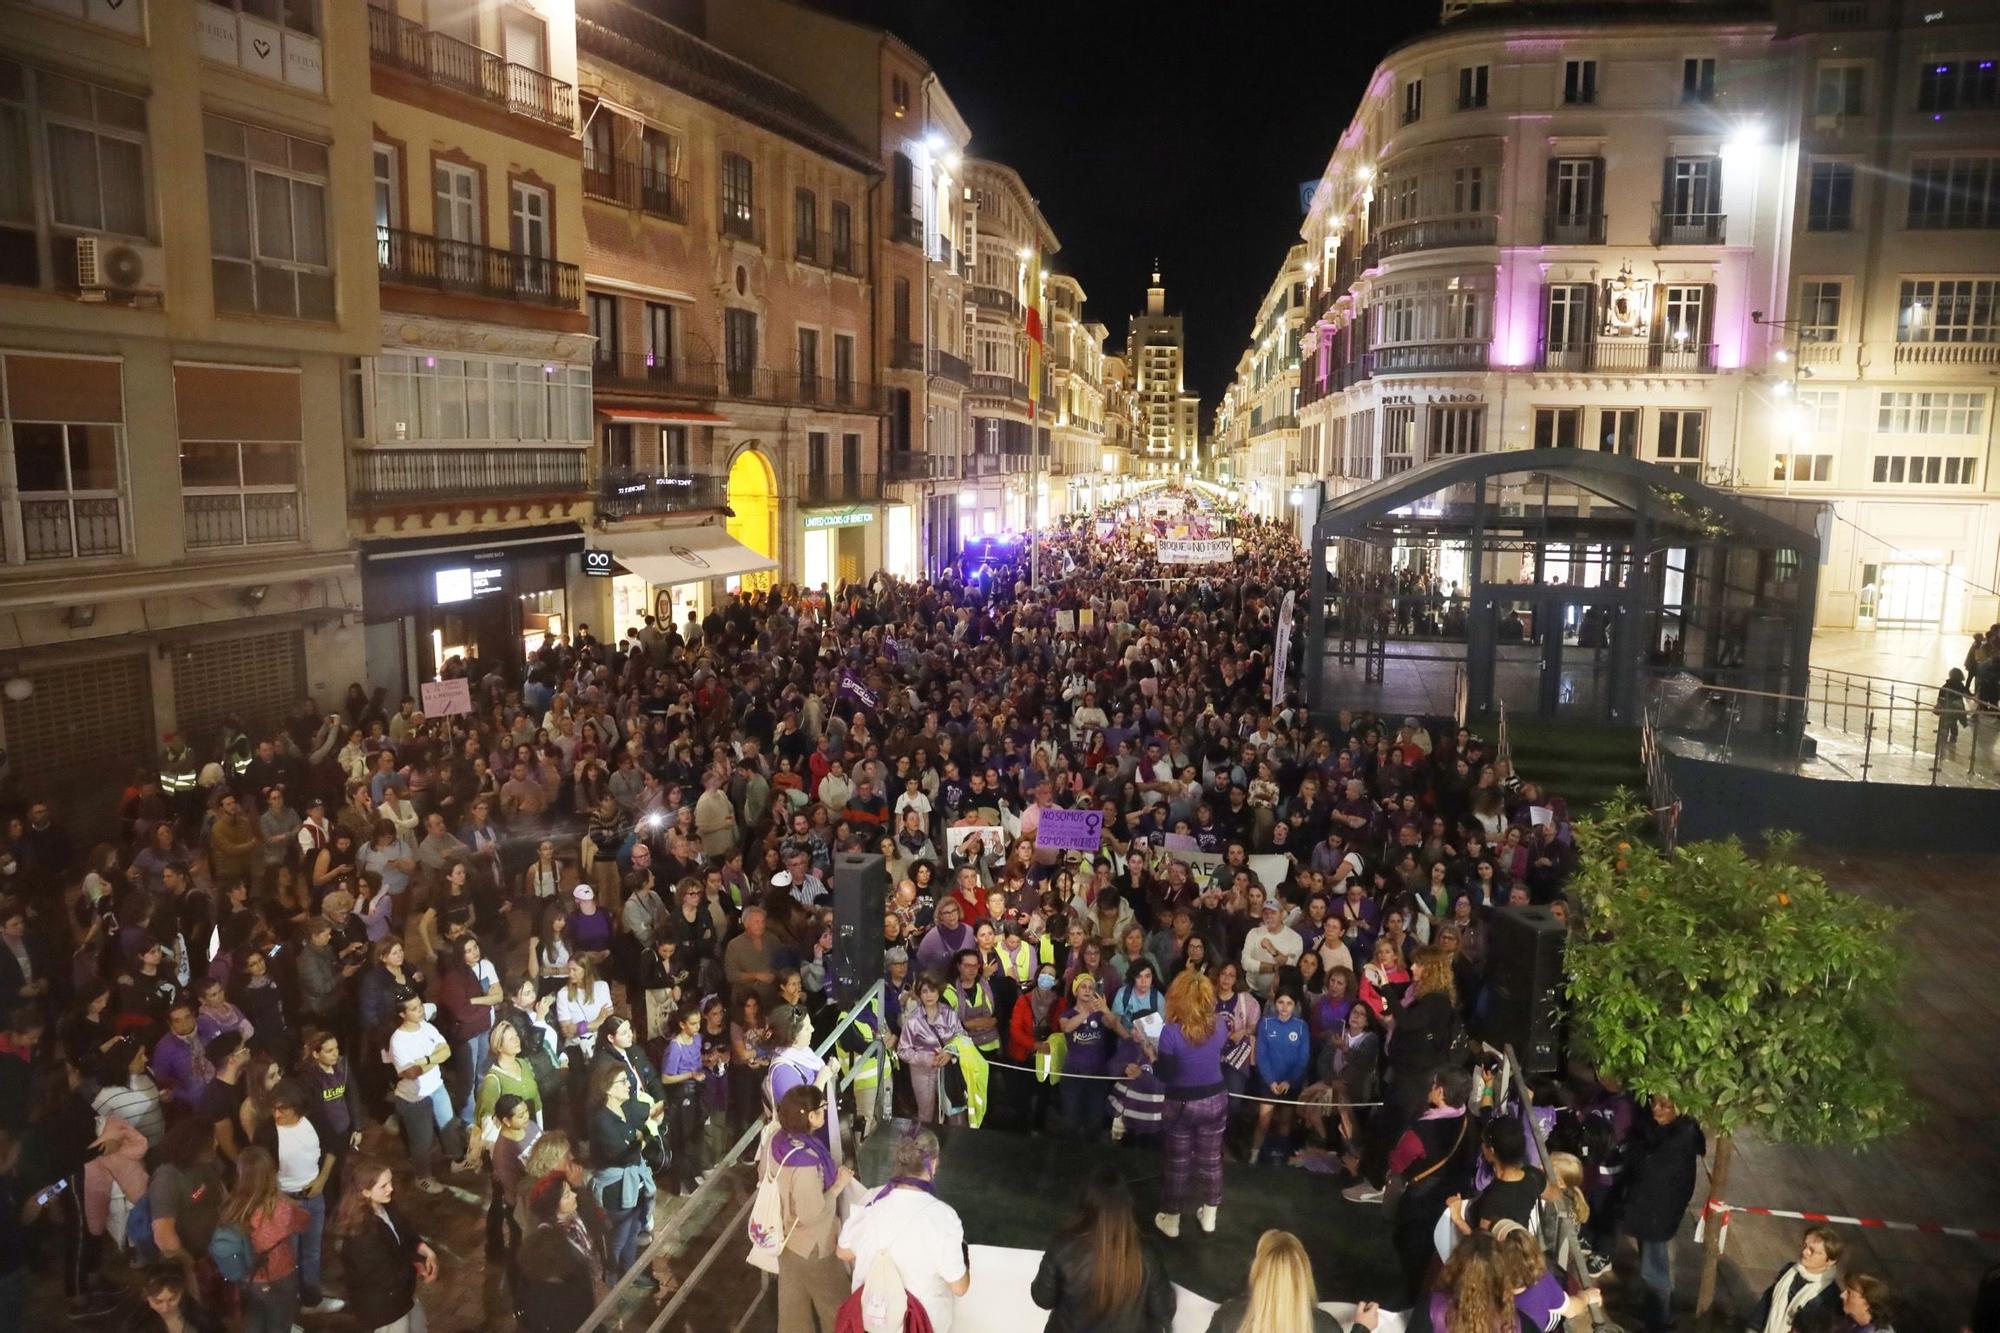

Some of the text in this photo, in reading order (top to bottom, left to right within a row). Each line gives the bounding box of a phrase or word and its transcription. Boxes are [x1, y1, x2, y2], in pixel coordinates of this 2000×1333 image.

[1042, 811, 1085, 822] NO SOMOS
[1039, 836, 1065, 847] SOMOS
